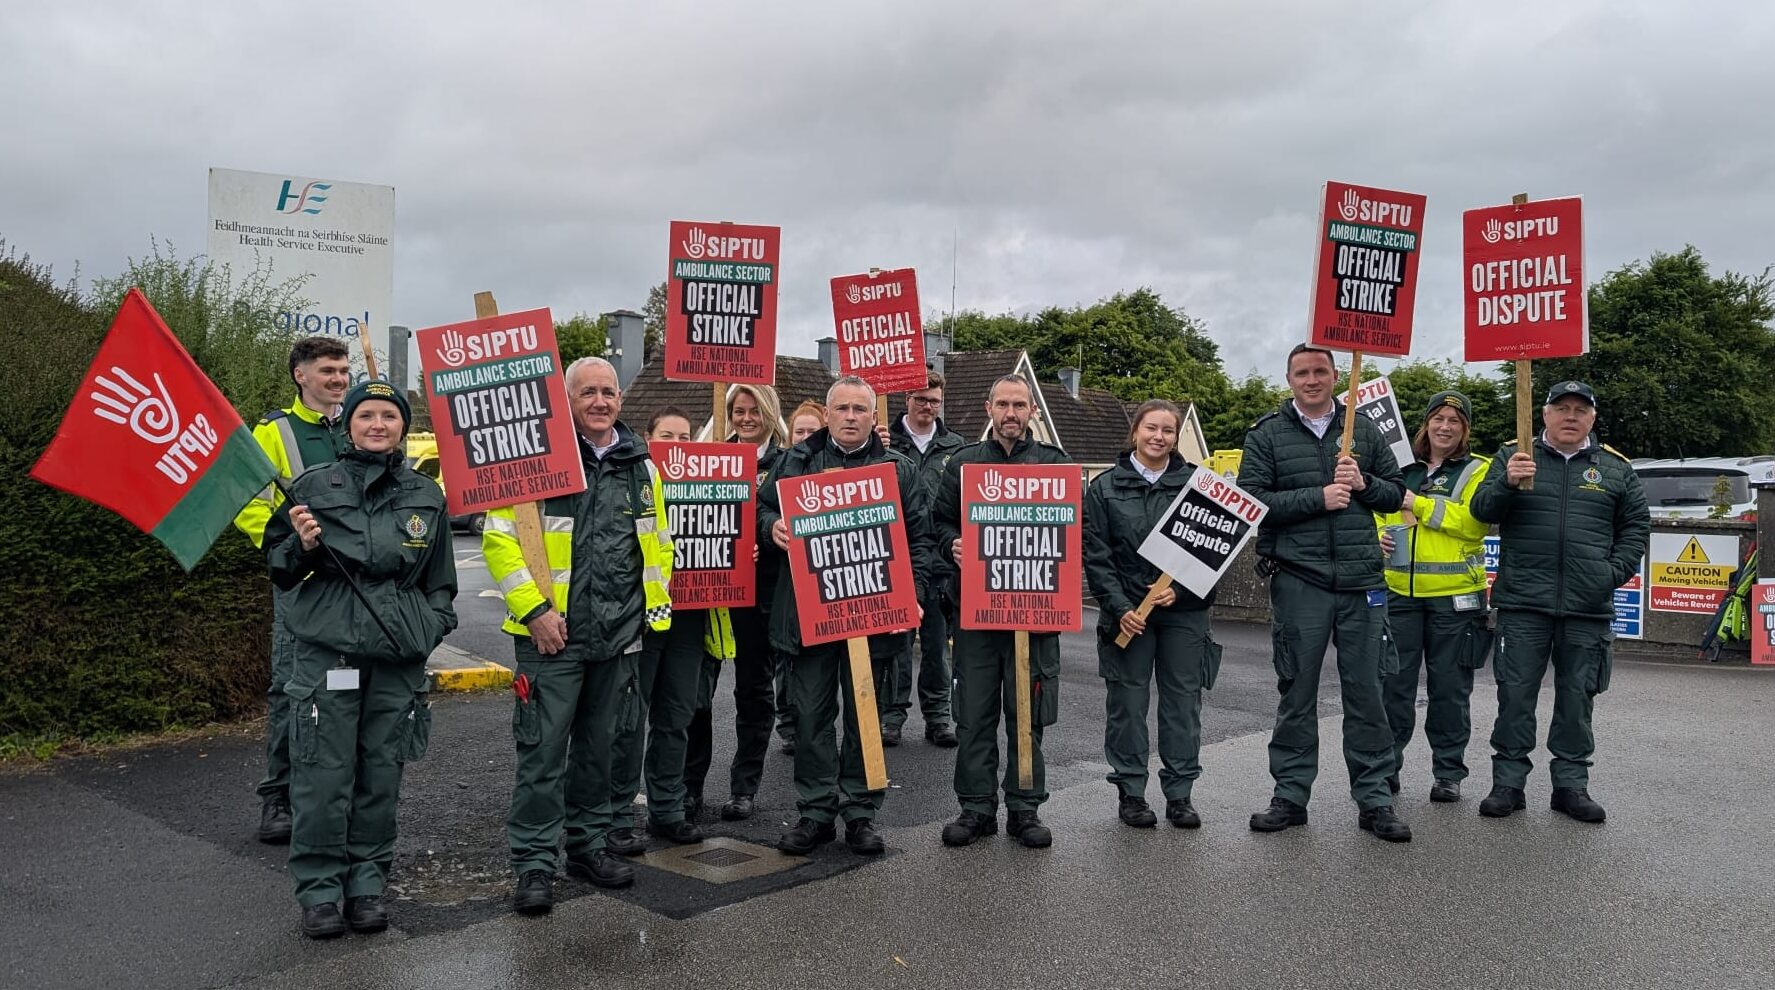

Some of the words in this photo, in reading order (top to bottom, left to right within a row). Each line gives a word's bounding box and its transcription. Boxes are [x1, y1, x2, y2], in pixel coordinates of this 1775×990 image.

[1360, 200, 1412, 226] SIPTU
[215, 220, 294, 237] Feidhmeannacht
[298, 230, 310, 238] na
[312, 230, 355, 243] Seirbhíse
[358, 234, 388, 246] Sláinte
[1330, 224, 1382, 245] AMBULANCE
[1384, 231, 1416, 250] SECTOR
[1504, 216, 1558, 240] SIPTU
[239, 234, 273, 248] Health
[277, 238, 314, 251] Service
[318, 242, 365, 255] Executive
[707, 236, 764, 260] SIPTU
[676, 262, 733, 279] AMBULANCE
[736, 265, 771, 281] SECTOR
[1337, 244, 1402, 282] OFFICIAL
[1472, 254, 1572, 292] OFFICIAL
[686, 282, 758, 314] OFFICIAL
[862, 282, 901, 301] SIPTU
[1340, 278, 1394, 314] STRIKE
[256, 305, 369, 338] gional
[1478, 290, 1567, 326] DISPUTE
[692, 314, 750, 345] STRIKE
[842, 312, 915, 343] OFFICIAL
[1338, 313, 1353, 327] HSE
[1355, 314, 1390, 332] NATIONAL
[466, 325, 538, 361] SIPTU
[1324, 326, 1369, 345] AMBULANCE
[1371, 331, 1403, 349] SERVICE
[1495, 342, 1550, 352] www.siptu.ie
[691, 347, 706, 360] HSE
[710, 349, 749, 363] NATIONAL
[848, 339, 914, 369] DISPUTE
[436, 364, 507, 392] AMBULANCE
[509, 356, 552, 379] SECTOR
[676, 360, 726, 376] AMBULANCE
[730, 364, 764, 378] SERVICE
[453, 381, 547, 429] OFFICIAL
[1343, 380, 1388, 405] SPTU
[470, 420, 545, 464] STRIKE
[476, 467, 497, 486] HSE
[500, 458, 550, 482] NATIONAL
[687, 455, 743, 477] SIPTU
[462, 481, 525, 506] AMBULANCE
[528, 471, 571, 494] SERVICE
[663, 484, 713, 500] MBULANCE
[716, 485, 749, 499] SECTOR
[822, 477, 883, 508] SIPTU
[1004, 478, 1066, 500] SIPTU
[1209, 482, 1262, 522] SIPTU
[668, 504, 738, 536] OFFICIAL
[794, 513, 856, 535] AMBULANCE
[858, 506, 895, 525] SECTOR
[971, 506, 1033, 521] AMBULANCE
[1036, 507, 1074, 522] SECTOR
[1180, 501, 1239, 535] Official
[810, 527, 890, 569] OFFICIAL
[984, 526, 1062, 558] OFFICIAL
[1171, 520, 1231, 554] Dispute
[675, 538, 731, 568] STRIKE
[674, 574, 689, 588] HSE
[693, 572, 731, 586] NATIONAL
[823, 561, 888, 600] STRIKE
[991, 559, 1054, 591] STRIKE
[1659, 576, 1690, 586] Moving
[1693, 578, 1728, 587] Vehicles
[1666, 566, 1721, 577] CAUTION
[672, 588, 709, 604] BULANCE
[712, 586, 745, 602] SERVICE
[827, 603, 844, 619] HSE
[847, 596, 892, 615] NATIONAL
[991, 595, 1007, 609] HSE
[1010, 595, 1055, 609] NATIONAL
[1654, 598, 1689, 608] Vehicles
[1691, 601, 1719, 610] Revers
[1671, 591, 1704, 600] Beware
[1706, 592, 1716, 600] of
[815, 616, 870, 637] AMBULANCE
[871, 608, 910, 627] SERVICE
[975, 610, 1030, 625] AMBULANCE
[1033, 611, 1071, 626] SERVICE
